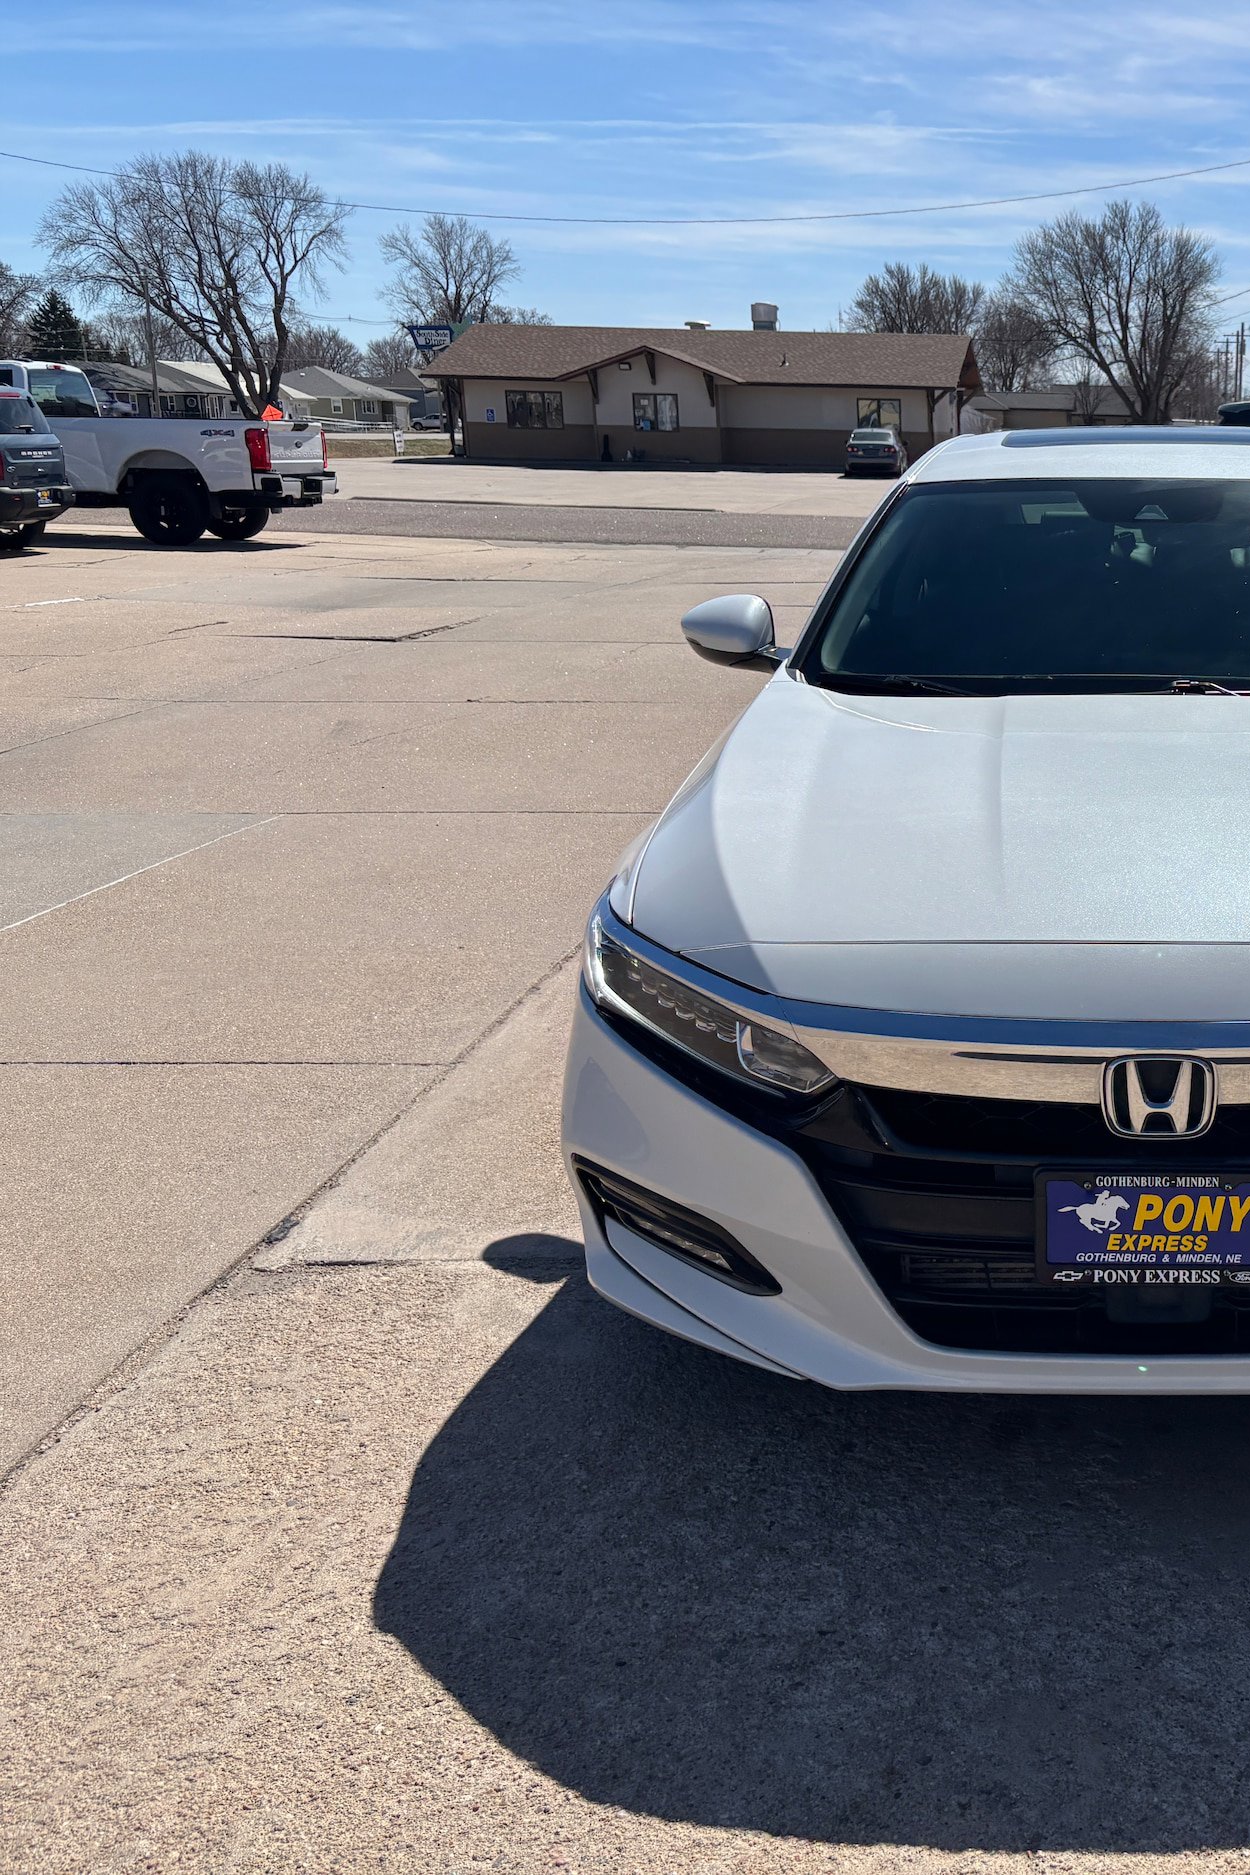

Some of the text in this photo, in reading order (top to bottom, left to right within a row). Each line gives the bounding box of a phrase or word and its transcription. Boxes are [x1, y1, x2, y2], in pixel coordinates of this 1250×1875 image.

[1095, 1176, 1220, 1188] GOTHENBURG-MINDEN
[1106, 1233, 1209, 1252] EXPRESS
[1075, 1252, 1242, 1264] GOTHENBURG & MINDEN, NE
[1092, 1269, 1221, 1284] PONY EXPRESS
